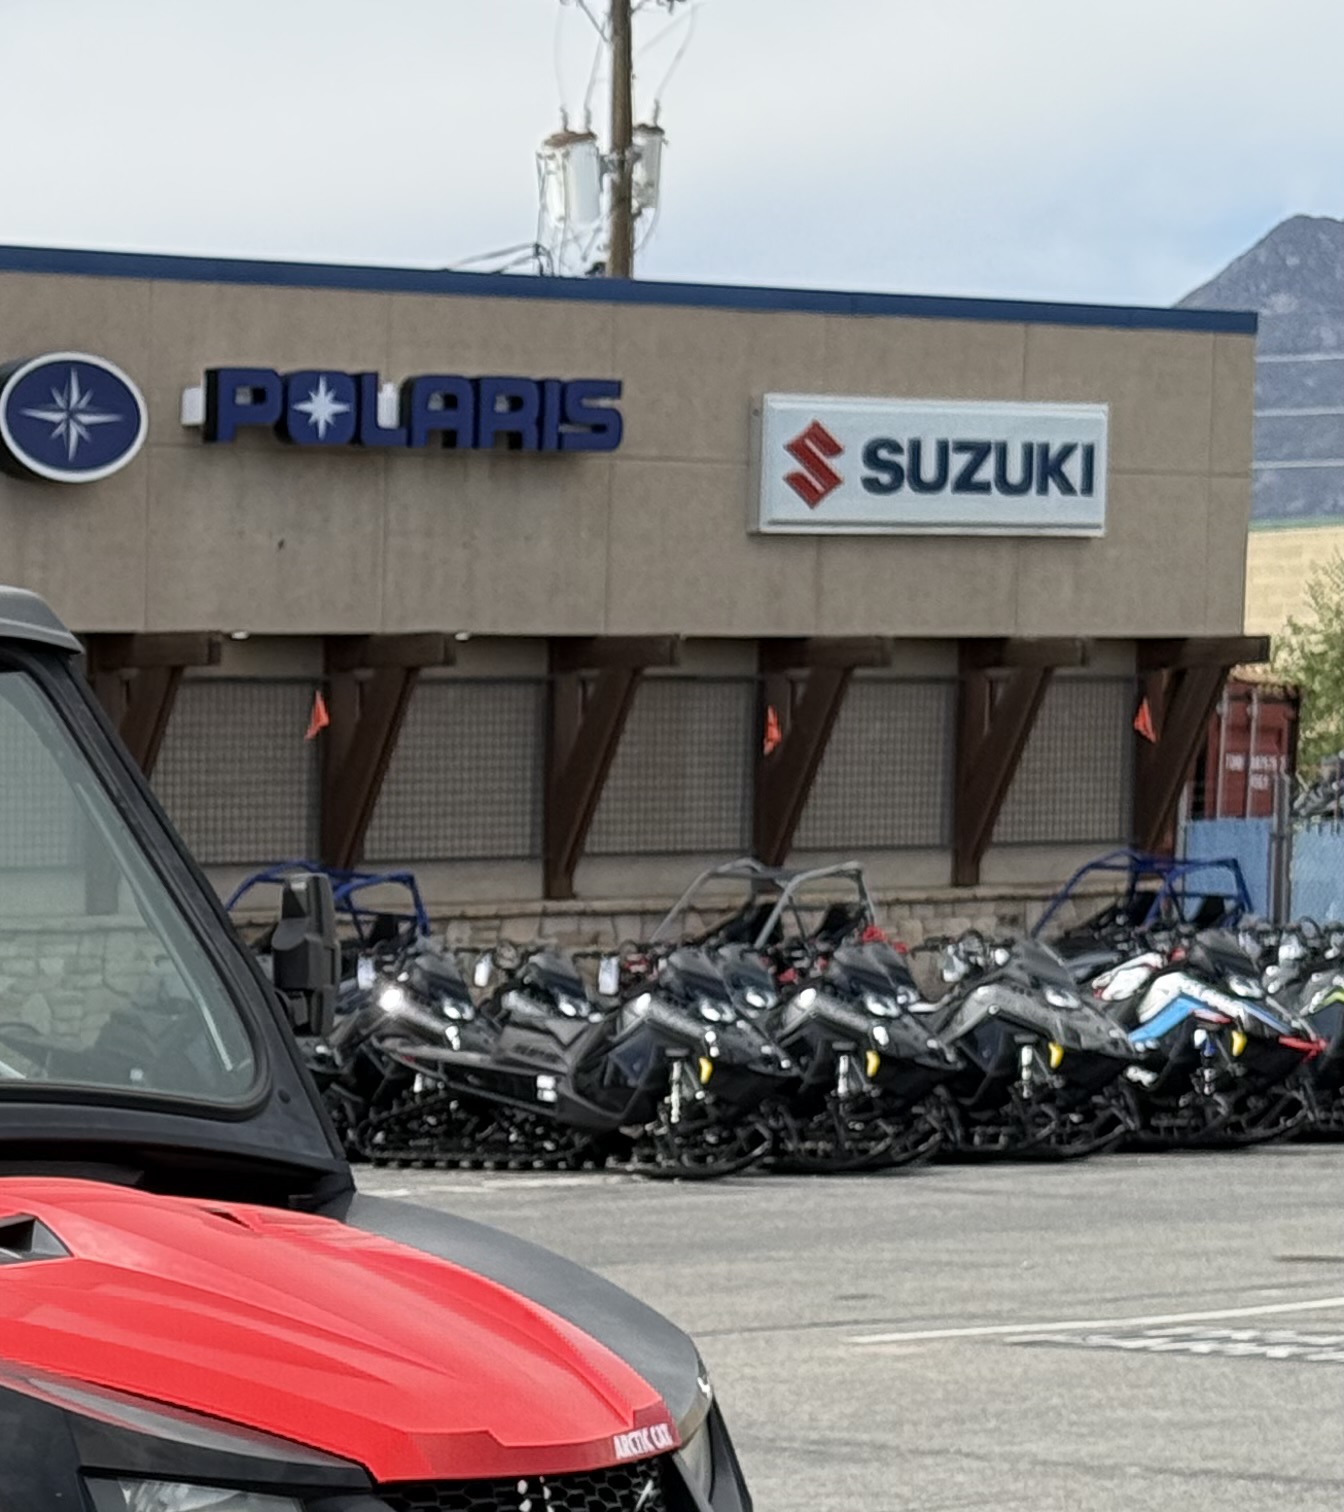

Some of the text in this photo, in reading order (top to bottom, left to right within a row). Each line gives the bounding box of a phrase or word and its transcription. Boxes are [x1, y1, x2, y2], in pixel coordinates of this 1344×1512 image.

[204, 367, 624, 453] POLARIS
[860, 437, 1095, 497] SUZUKI
[613, 1422, 674, 1460] ARCTIC CAT
